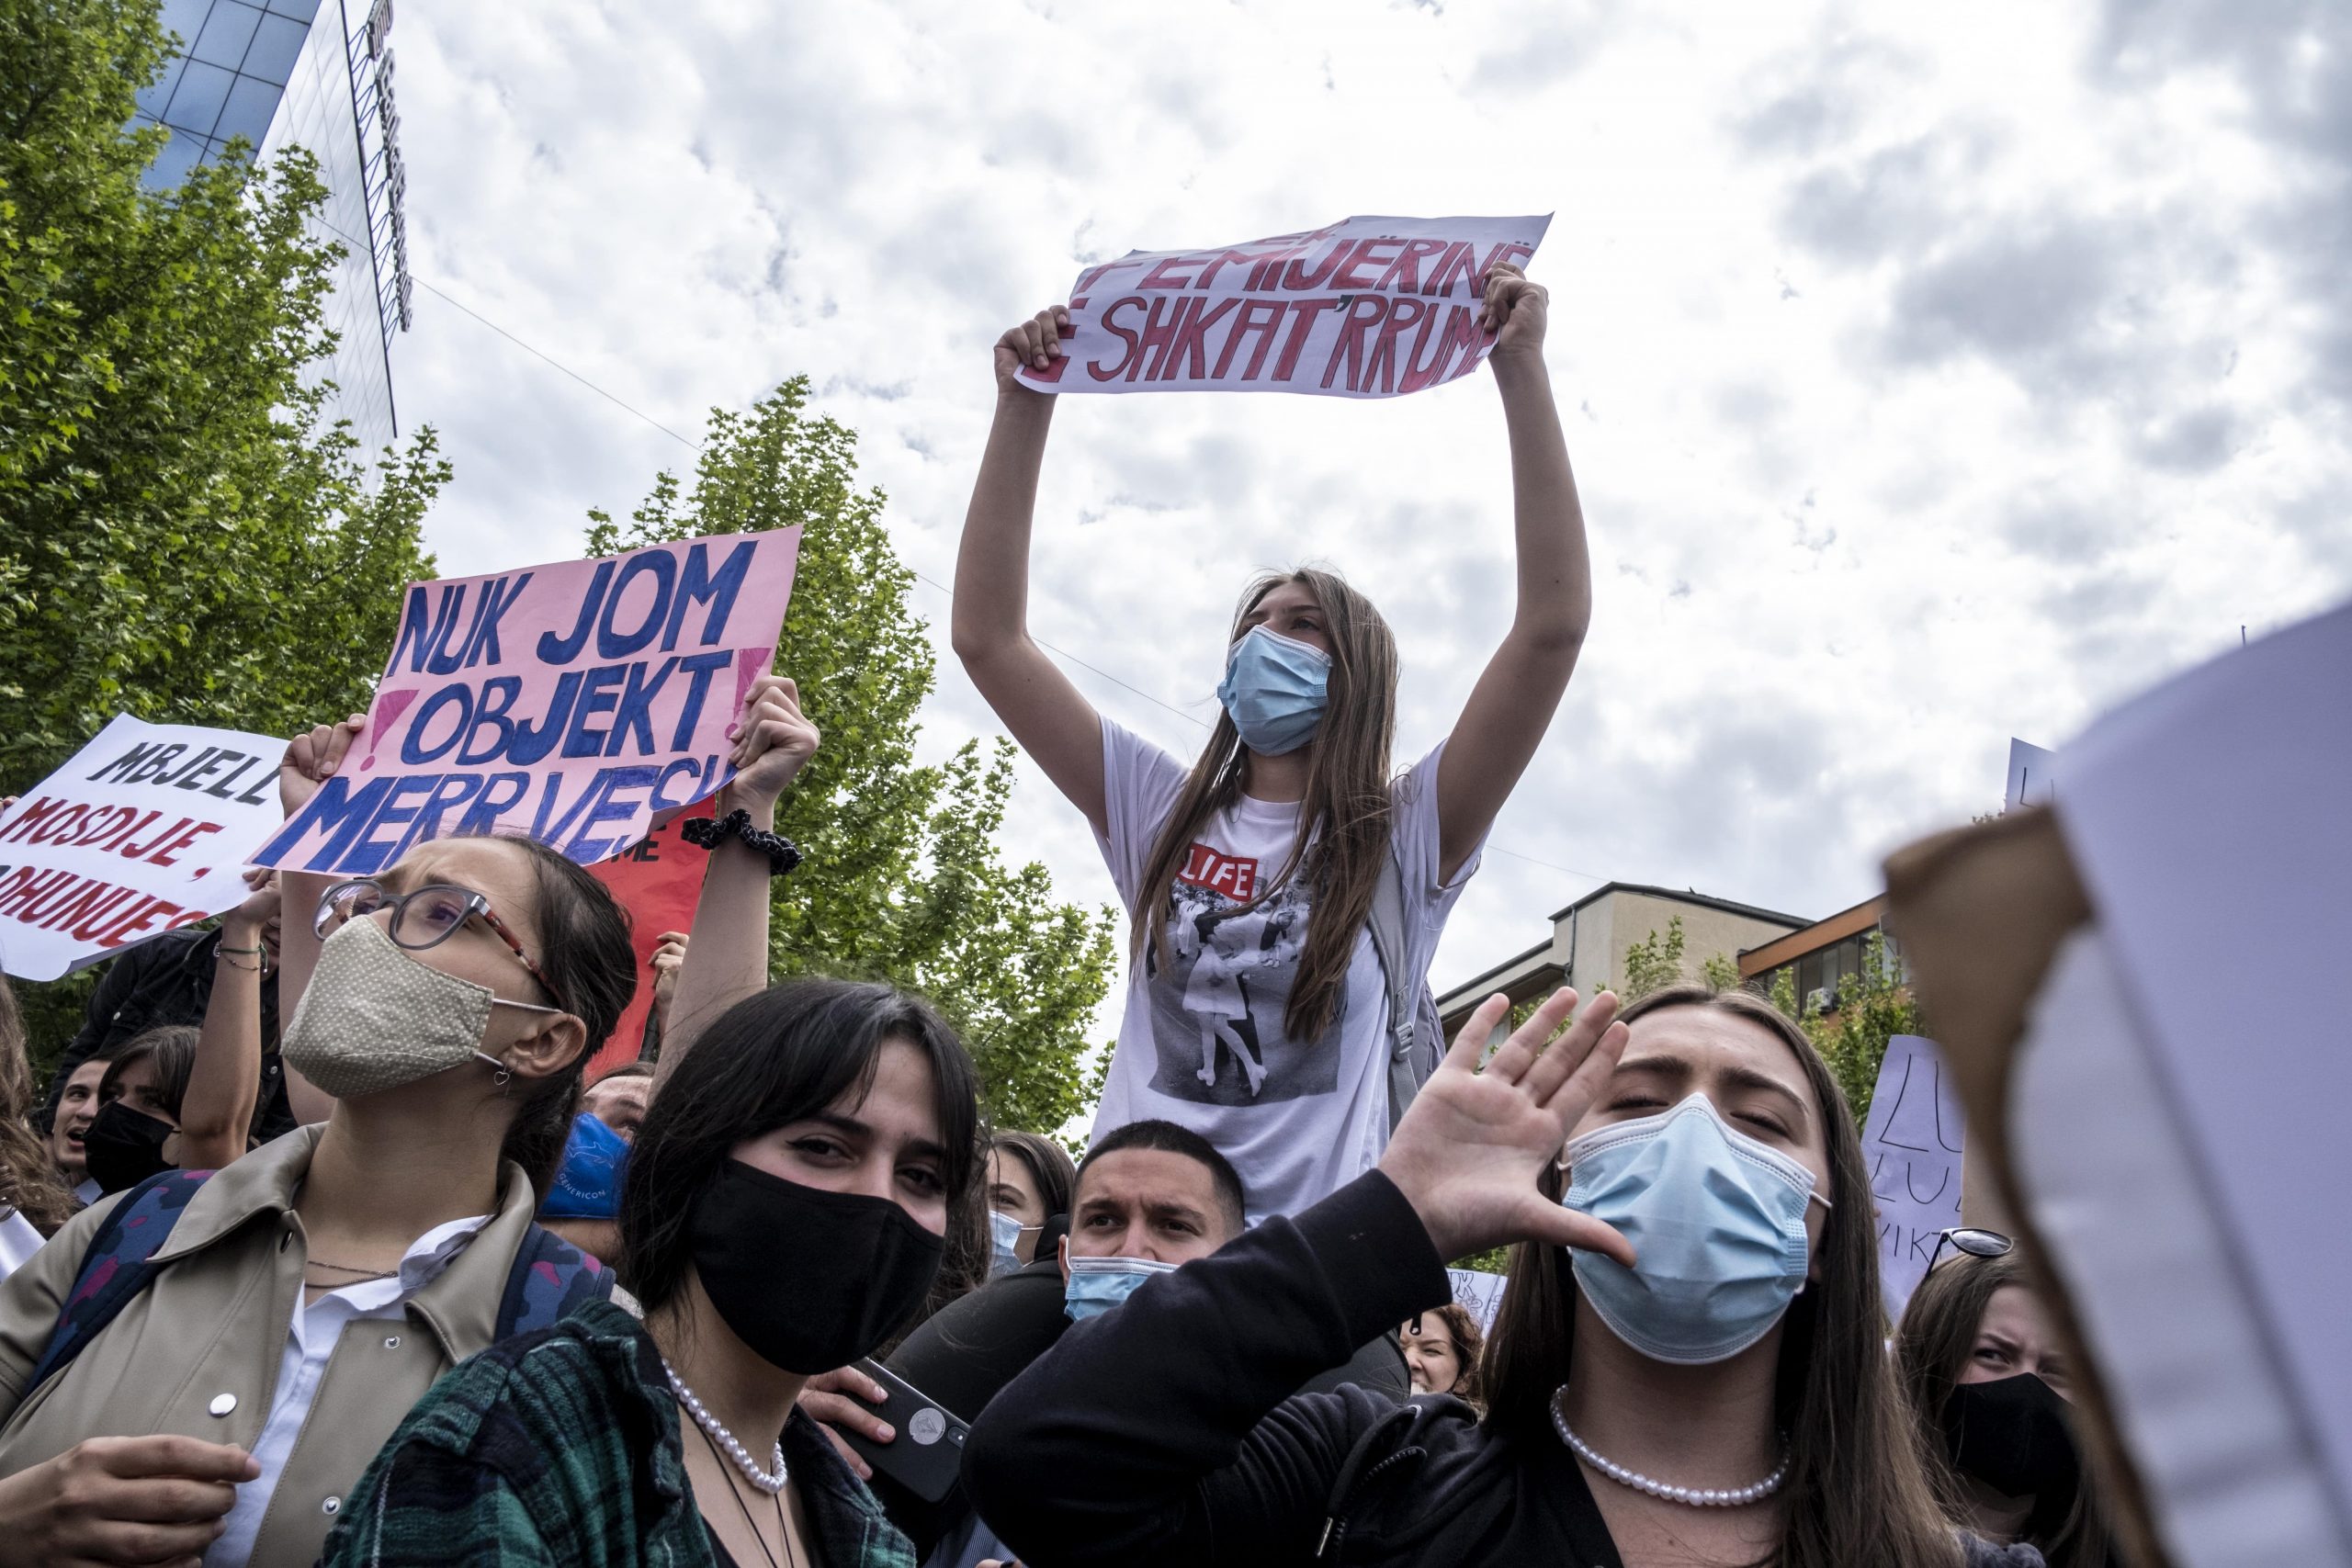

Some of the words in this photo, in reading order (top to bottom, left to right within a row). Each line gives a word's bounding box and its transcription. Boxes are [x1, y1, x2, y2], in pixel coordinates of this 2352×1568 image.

[388, 572, 535, 678] NUK
[537, 540, 760, 665] JOM
[401, 649, 733, 766] OBJEKT
[252, 772, 530, 874] MERR
[1180, 848, 1251, 897] LIFE
[559, 1173, 606, 1200] GENERICON
